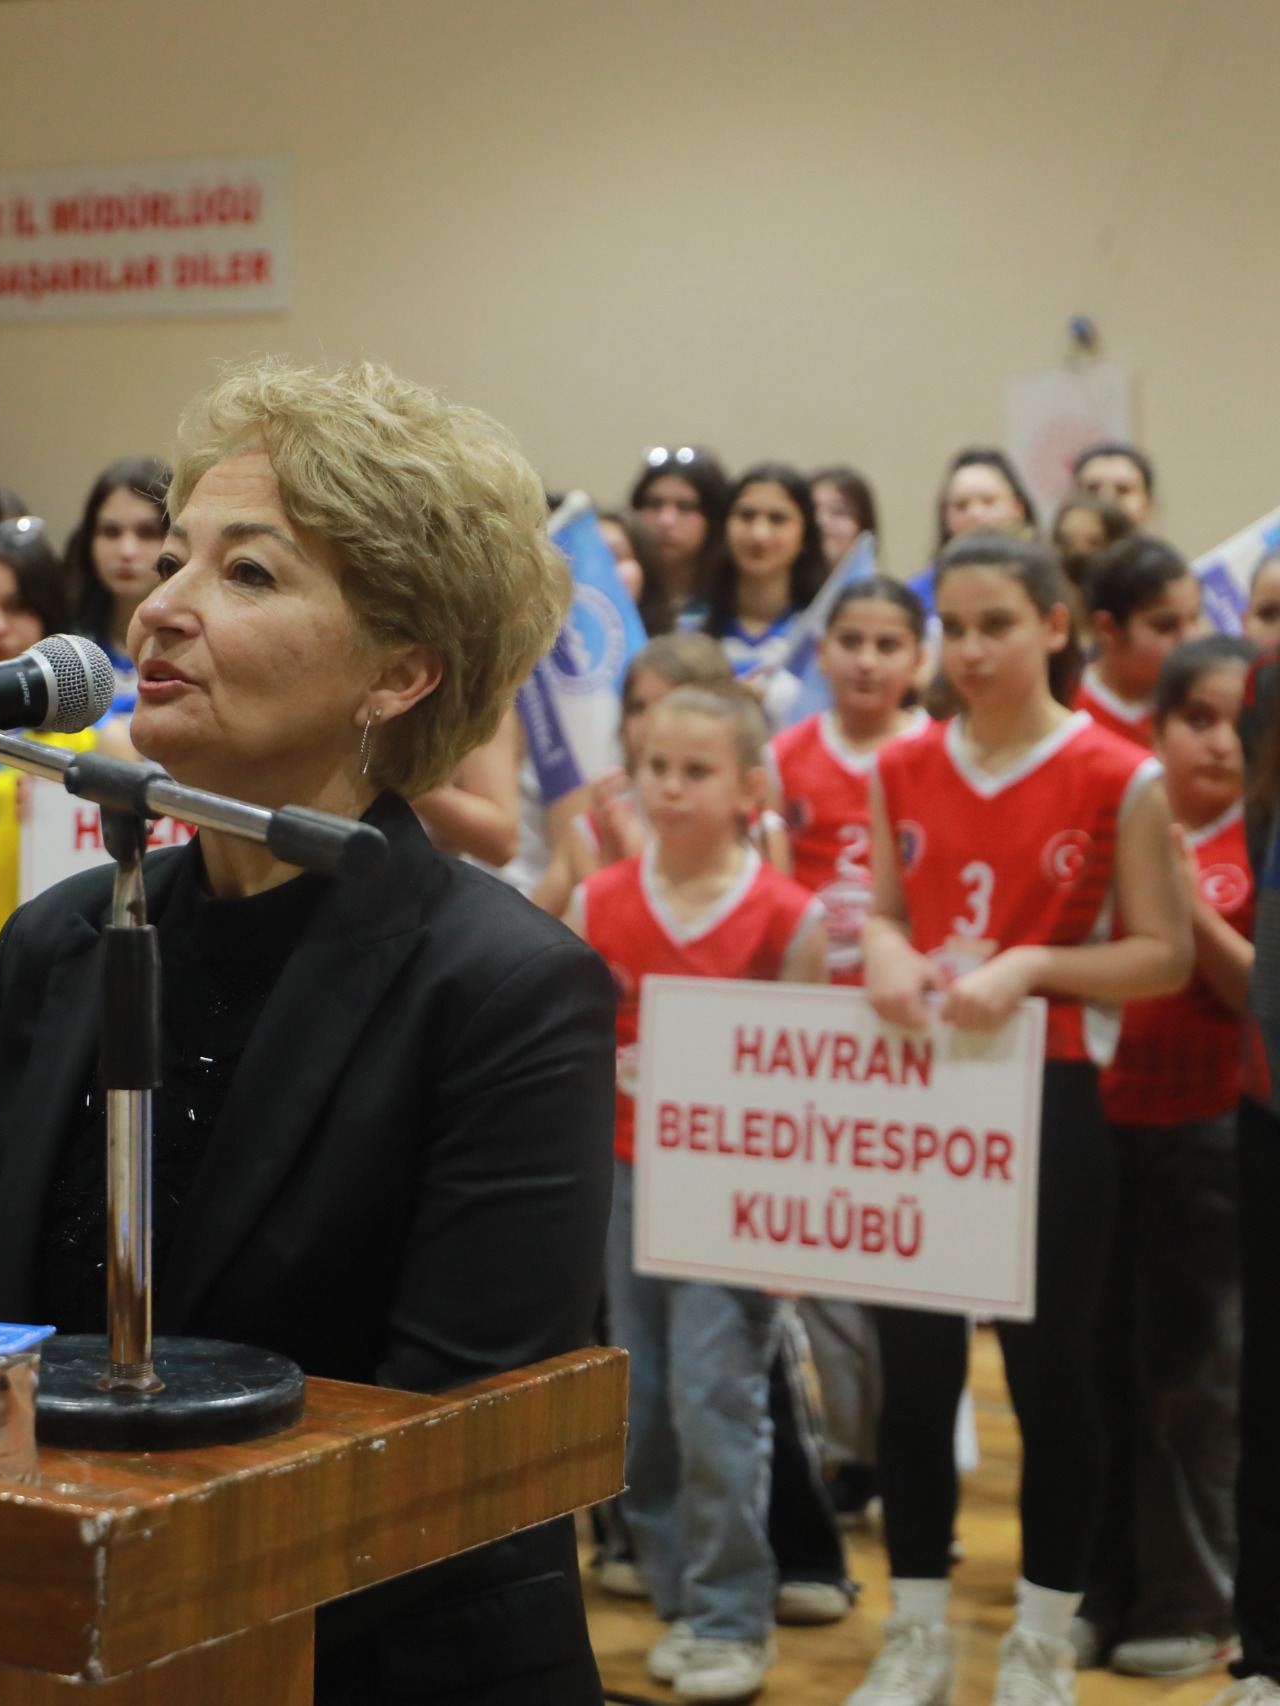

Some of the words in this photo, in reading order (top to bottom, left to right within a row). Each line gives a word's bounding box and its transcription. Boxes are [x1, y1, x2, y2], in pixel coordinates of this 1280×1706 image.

[51, 184, 262, 234] MÜDÜRLÜĞÜ
[175, 249, 272, 290] DİLER
[16, 671, 31, 706] SHURE
[836, 823, 872, 880] 2
[954, 860, 994, 938] 3
[733, 1025, 934, 1087] HAVRAN
[657, 1102, 1014, 1182] BELEDİYESPOR
[731, 1190, 923, 1258] KULÜBÜ
